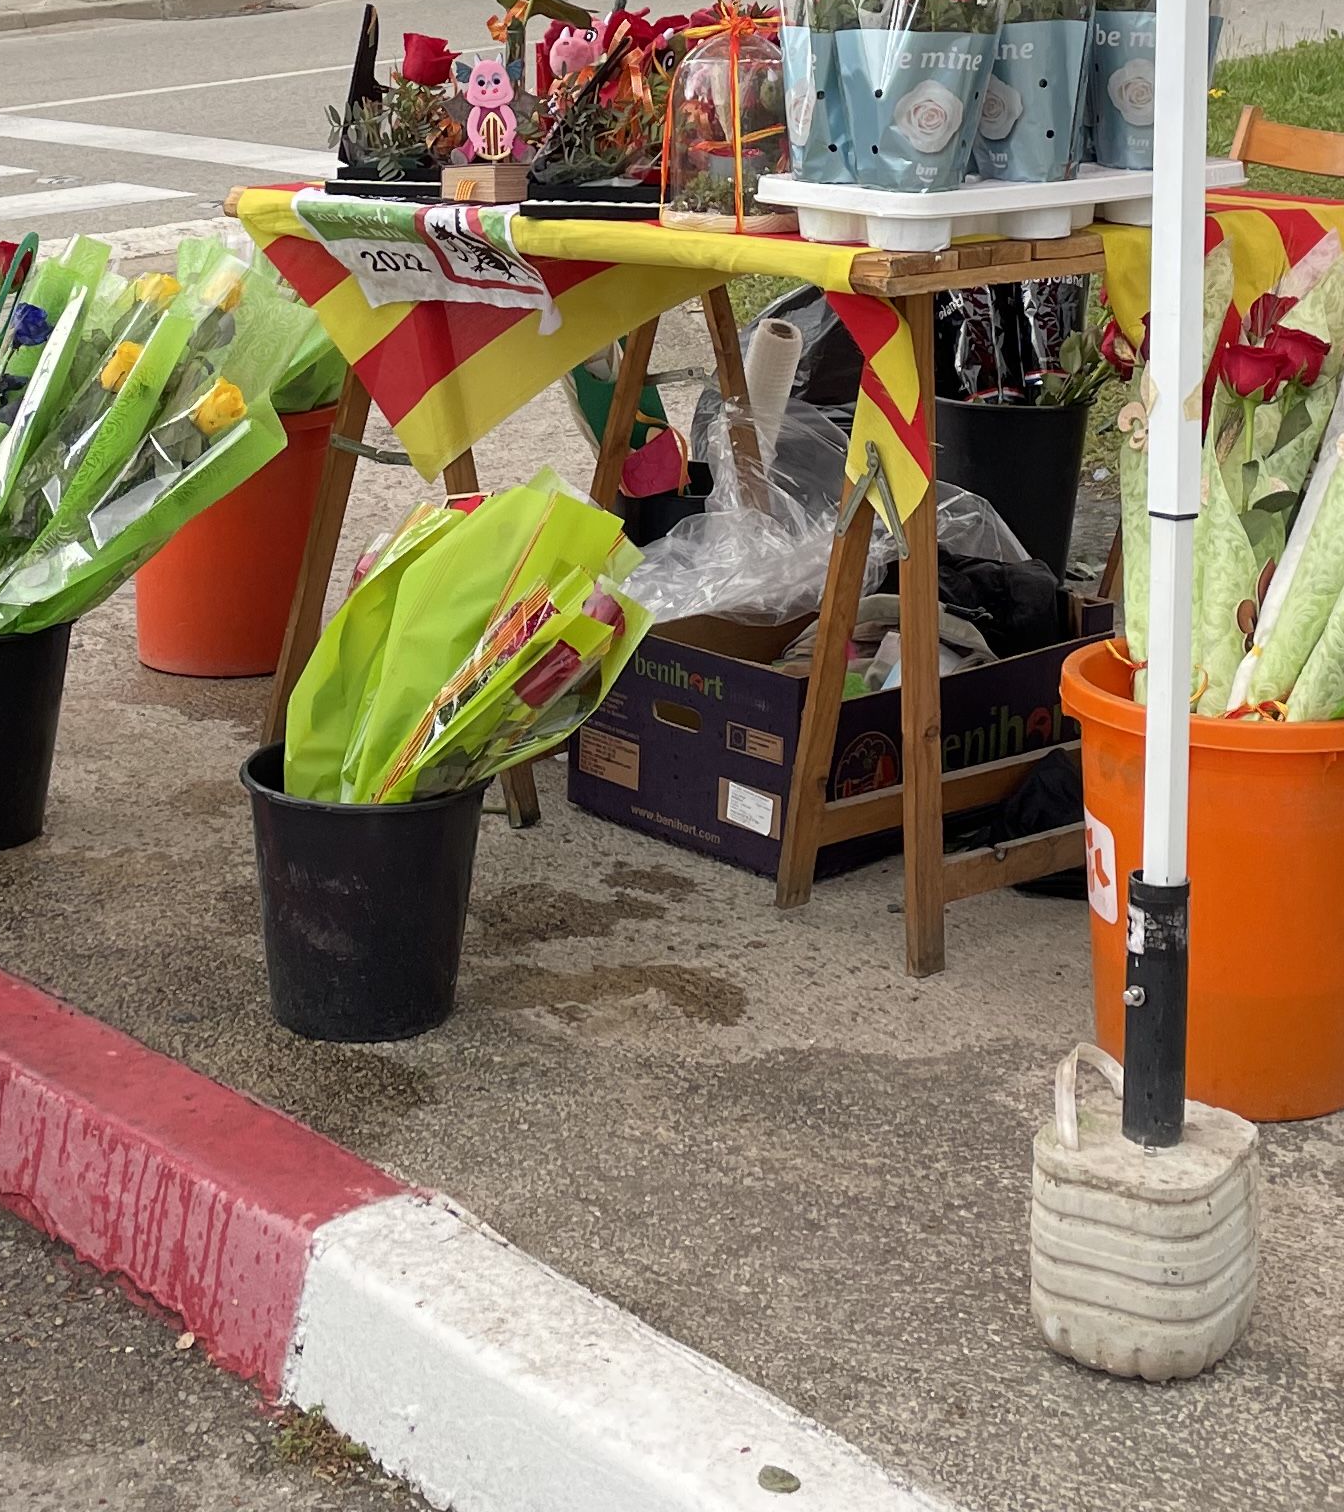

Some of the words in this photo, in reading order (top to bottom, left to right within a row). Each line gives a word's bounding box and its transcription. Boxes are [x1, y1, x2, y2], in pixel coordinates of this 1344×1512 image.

[1095, 23, 1121, 47] be
[920, 46, 983, 71] mine
[915, 162, 938, 176] bm
[360, 250, 432, 272] 2022
